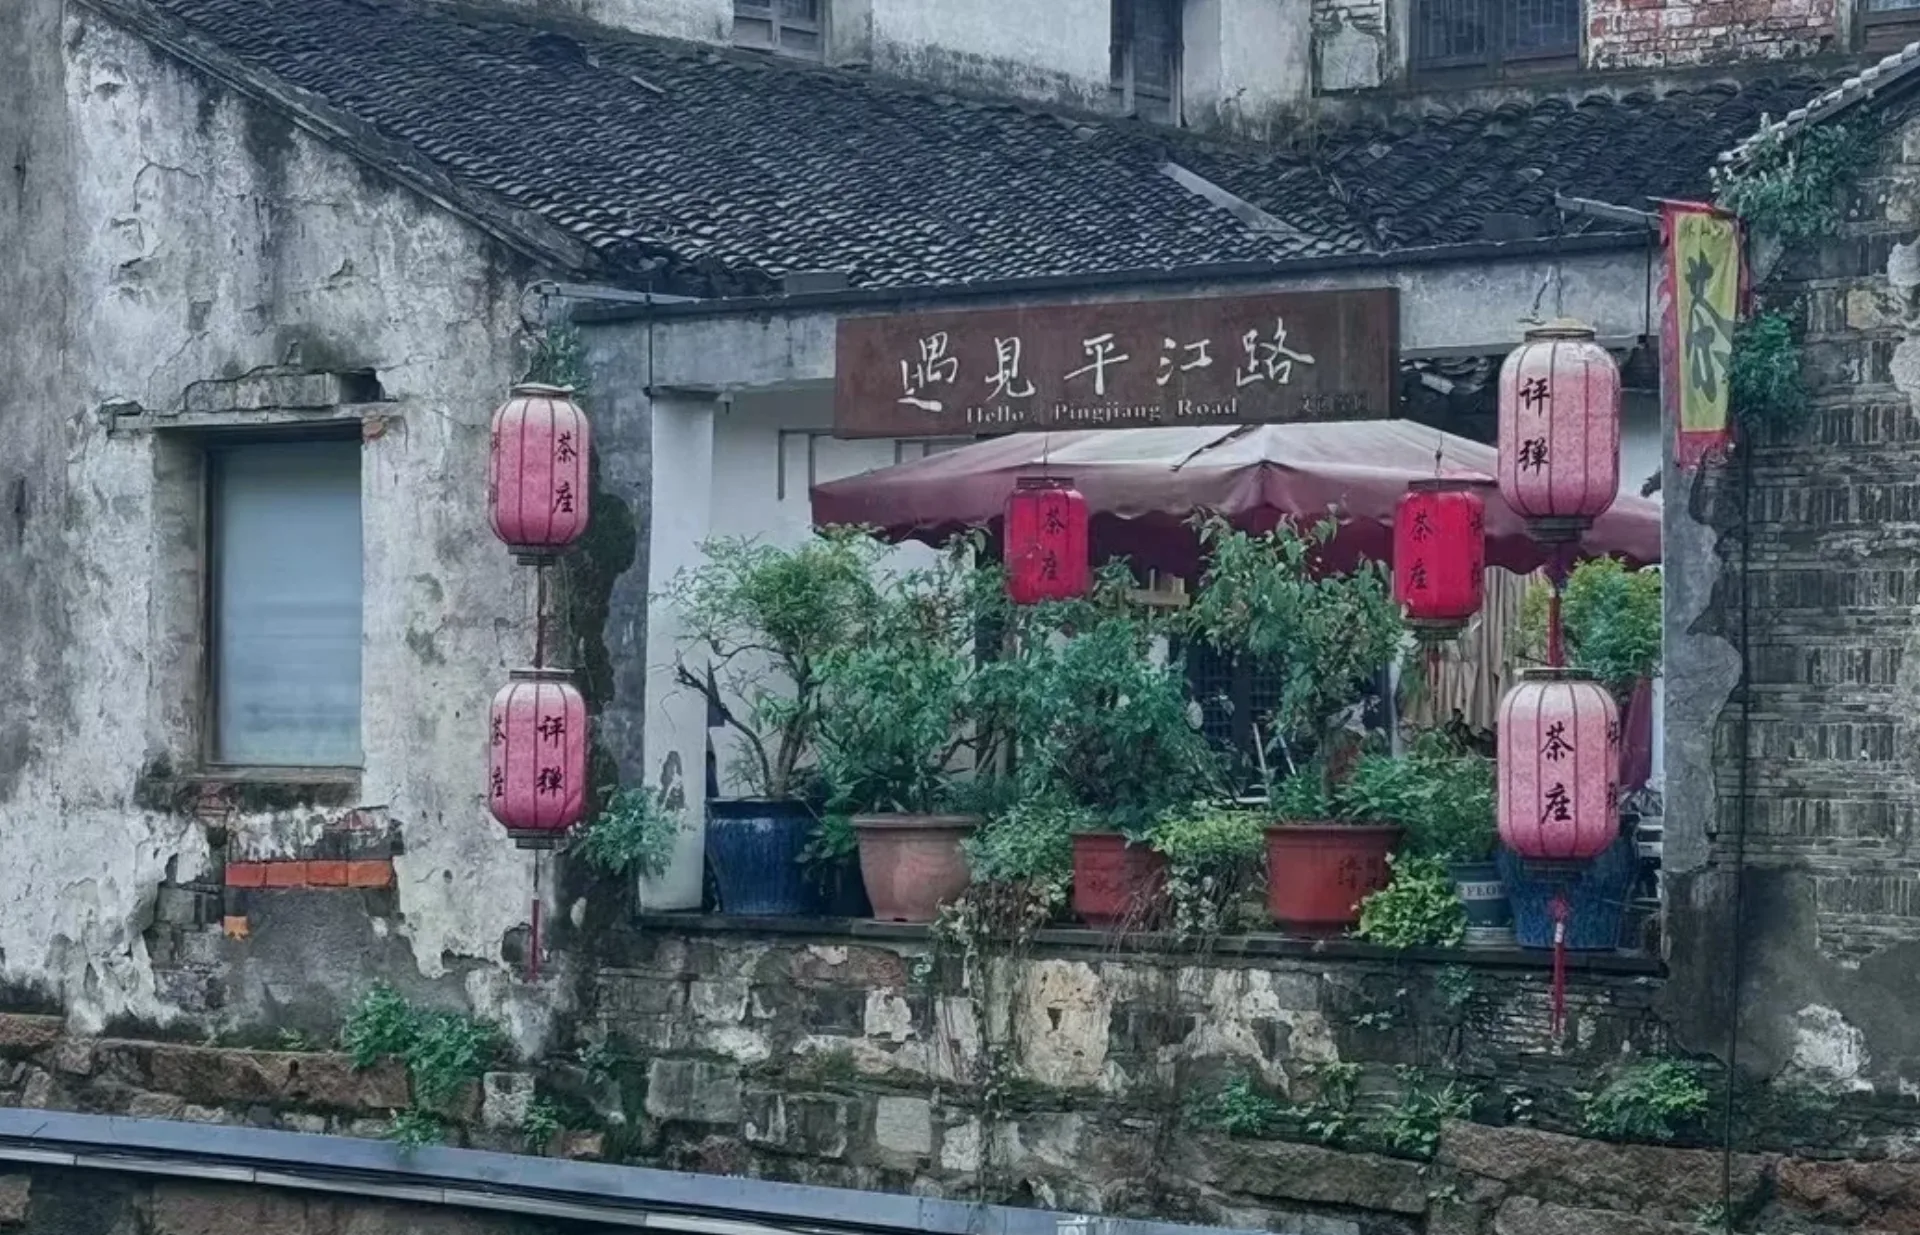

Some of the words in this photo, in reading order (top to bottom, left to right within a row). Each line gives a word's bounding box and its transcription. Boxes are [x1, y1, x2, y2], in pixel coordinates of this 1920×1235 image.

[1055, 401, 1162, 424] Pingjiang
[1177, 397, 1237, 416] Road
[552, 430, 578, 514] 茶座
[1406, 507, 1433, 594] 茶座
[1540, 720, 1575, 825] 茶座
